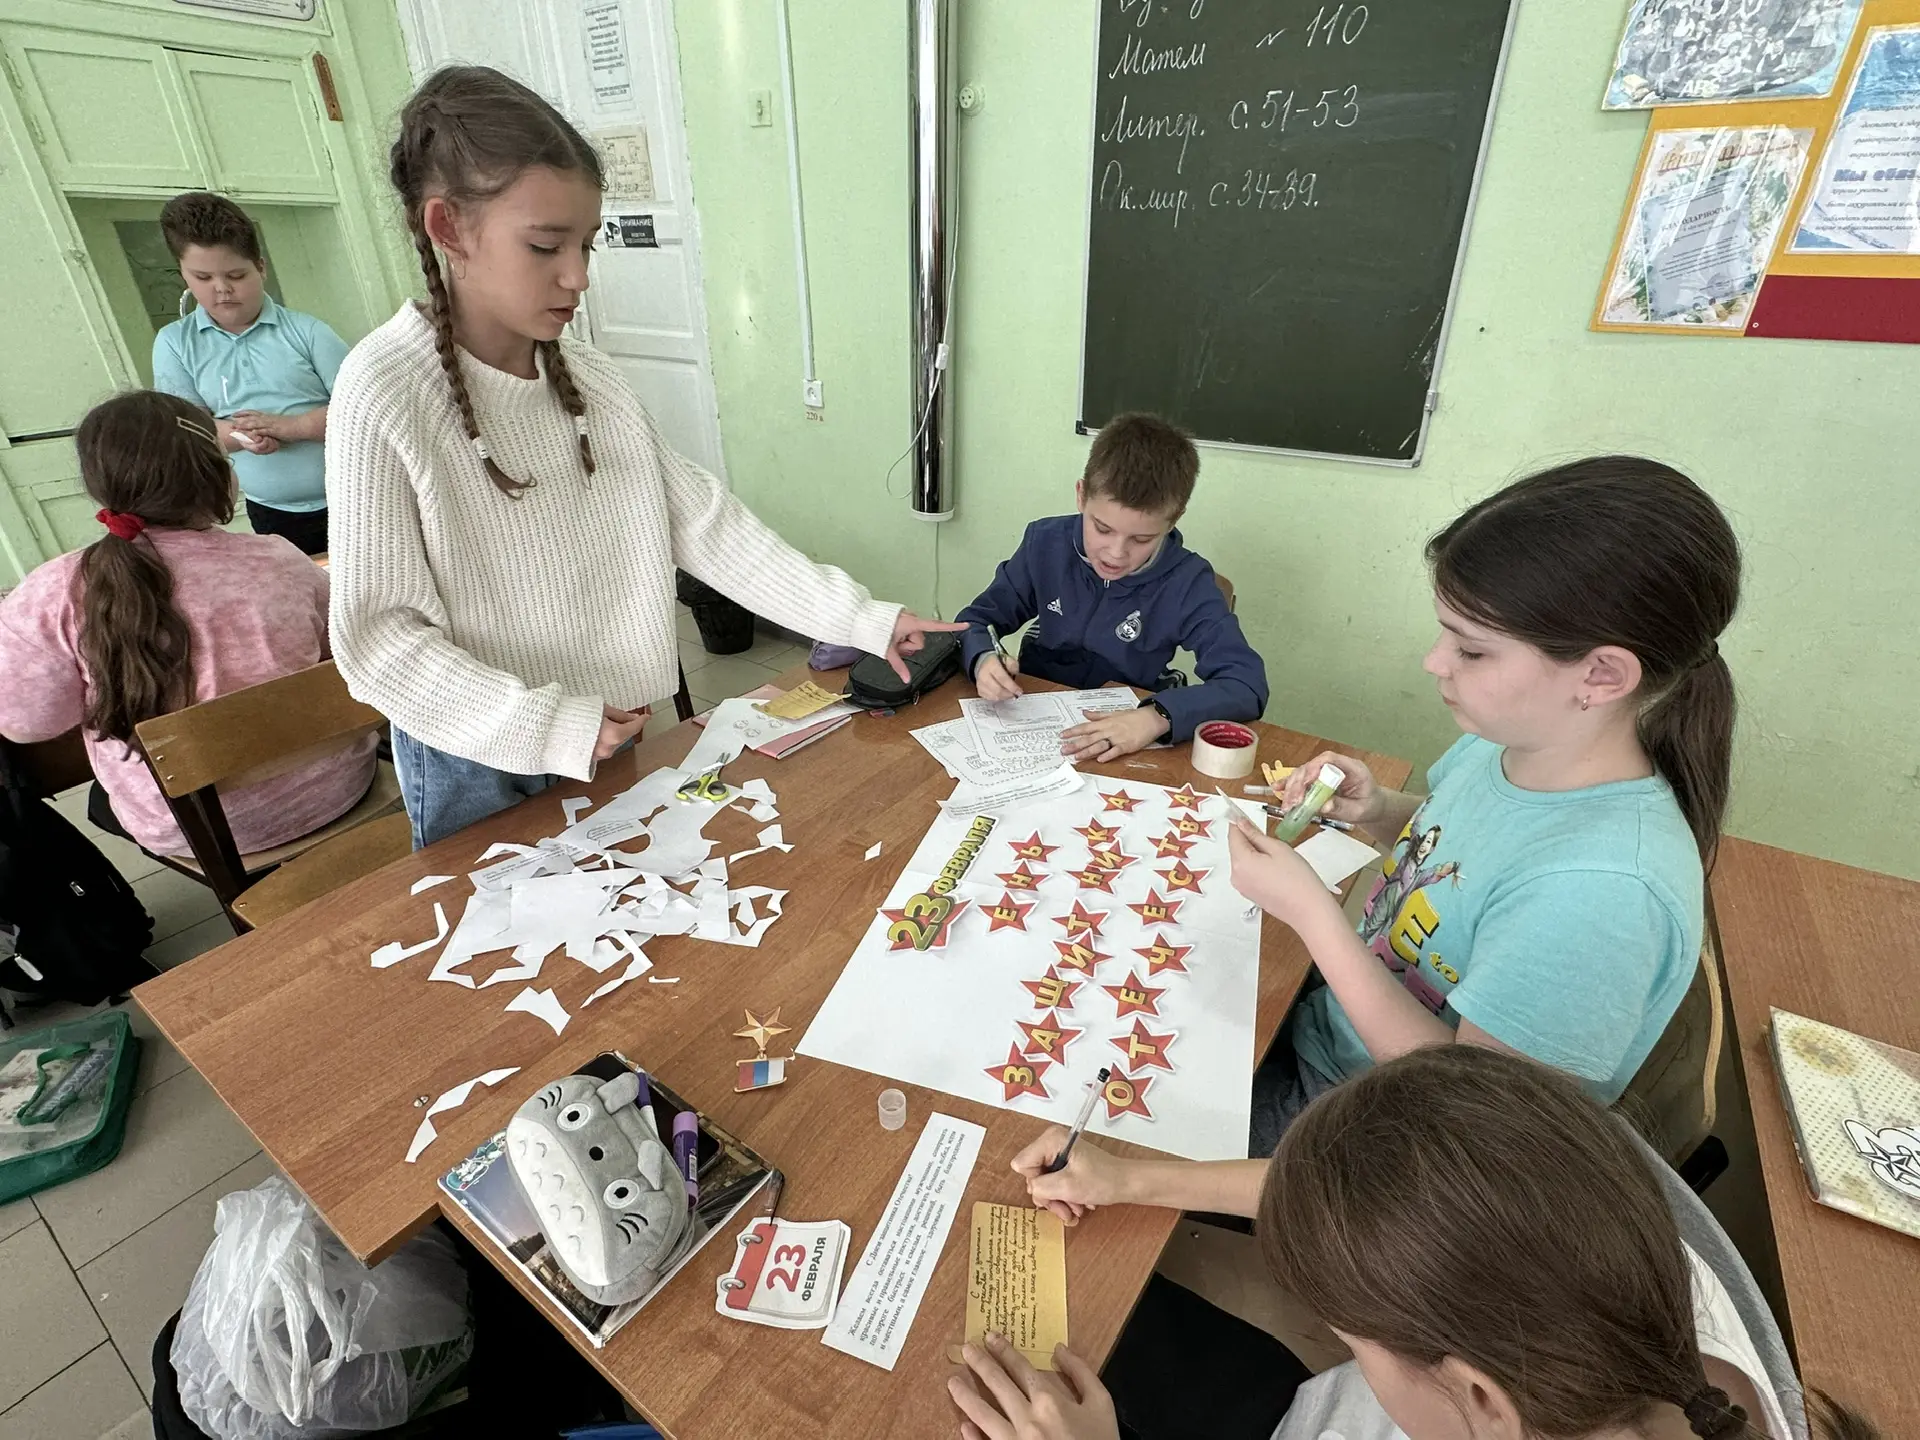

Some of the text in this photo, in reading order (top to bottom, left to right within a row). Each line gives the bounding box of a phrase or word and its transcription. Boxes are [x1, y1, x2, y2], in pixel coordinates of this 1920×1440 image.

[1108, 33, 1206, 79] Матем
[1307, 3, 1369, 47] 110
[1101, 95, 1205, 175] Литер.
[1260, 84, 1359, 132] 51-53
[887, 893, 955, 952] 23
[932, 815, 996, 895] ФЕВРАЛЯ
[766, 1244, 806, 1292] 23
[801, 1237, 827, 1302] ФЕВРАЛЯ
[848, 1308, 866, 1335] Желаем
[865, 1280, 878, 1303] всегда
[878, 1240, 896, 1275] оставаться
[860, 1307, 878, 1341] красивые
[879, 1257, 900, 1298] правильные
[875, 1309, 888, 1334] дороге
[908, 1234, 921, 1258] смелых
[902, 1277, 914, 1297] самое
